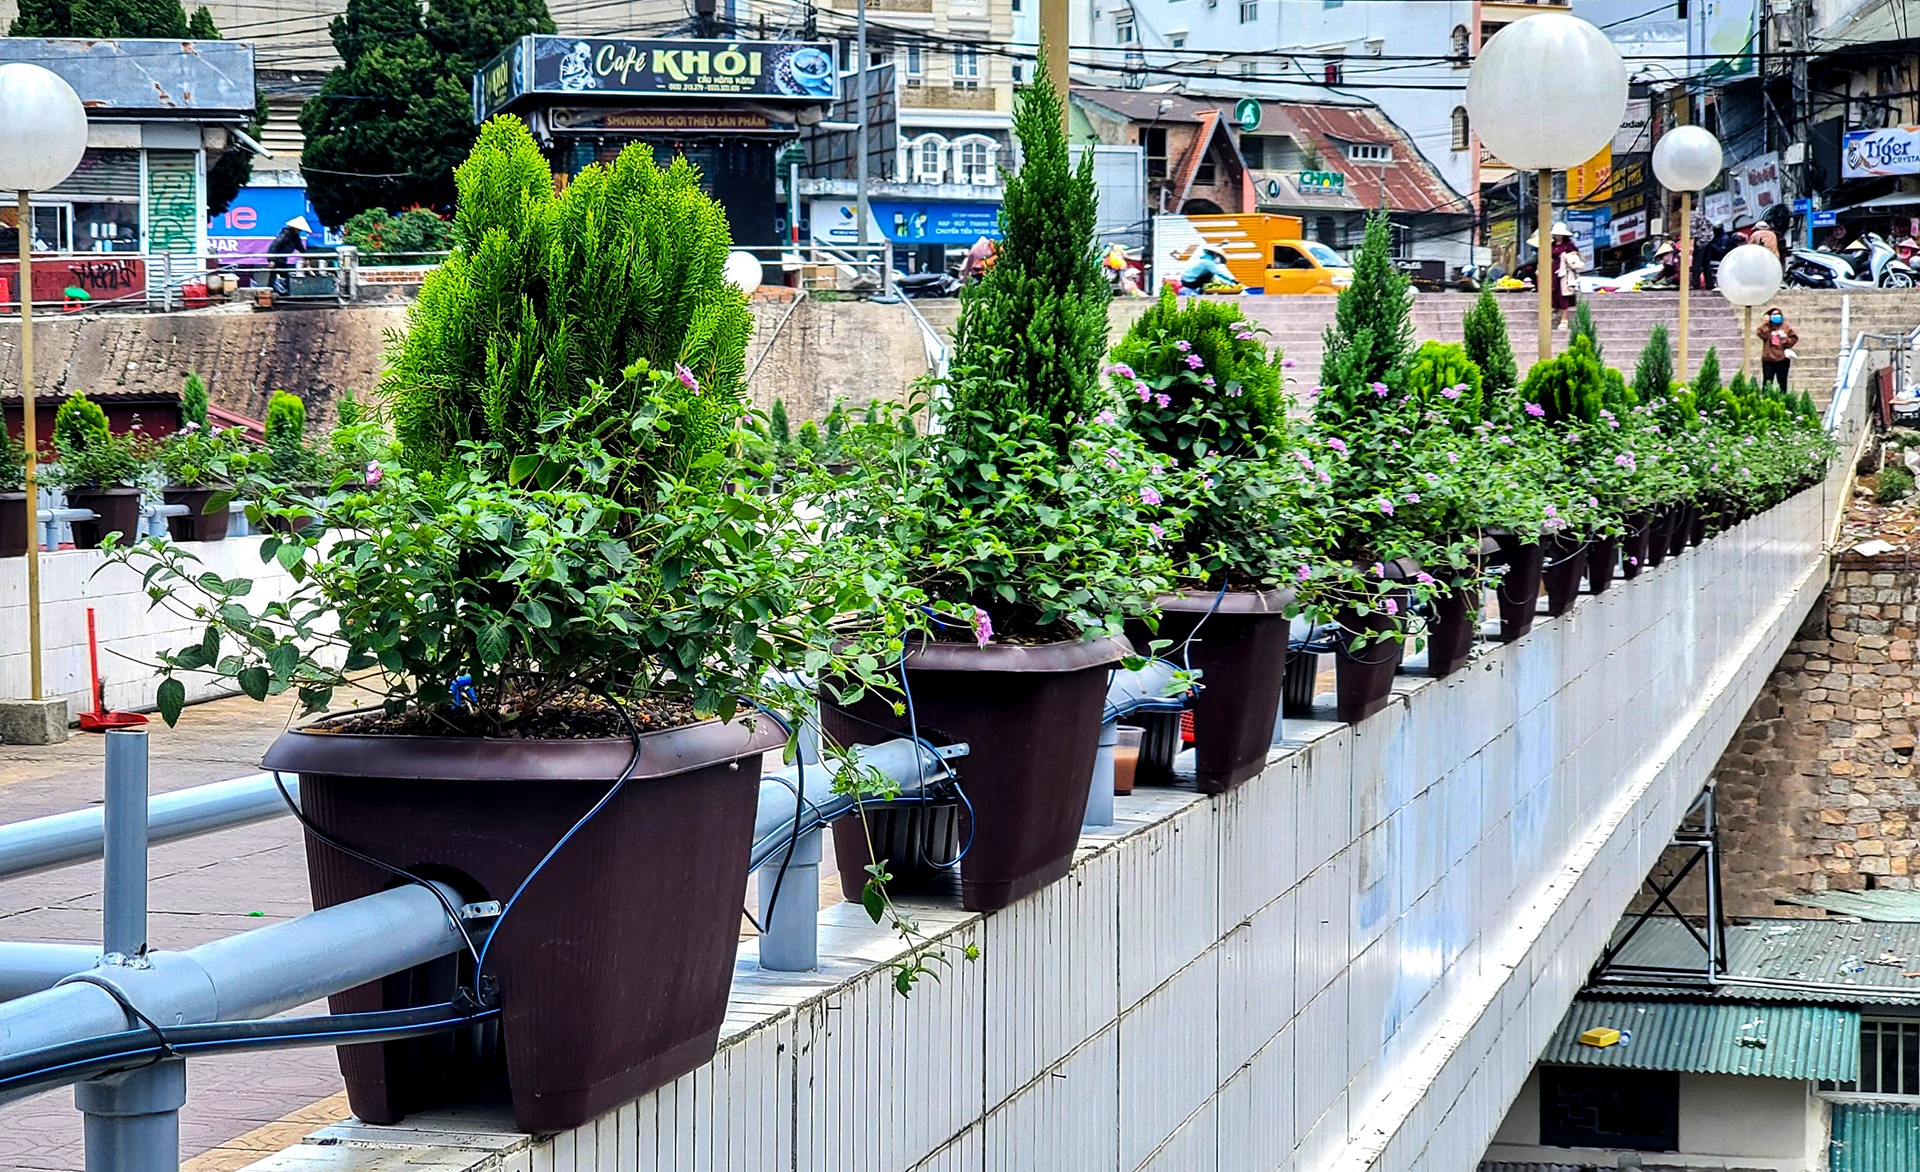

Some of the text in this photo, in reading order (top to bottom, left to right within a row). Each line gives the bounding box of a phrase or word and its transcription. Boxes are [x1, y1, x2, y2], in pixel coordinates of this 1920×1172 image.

[595, 44, 762, 85] Café KHÓI
[606, 115, 665, 126] SHOWROOM
[688, 114, 715, 128] THIỆU
[1619, 119, 1645, 129] odak
[1865, 137, 1911, 165] Tiger
